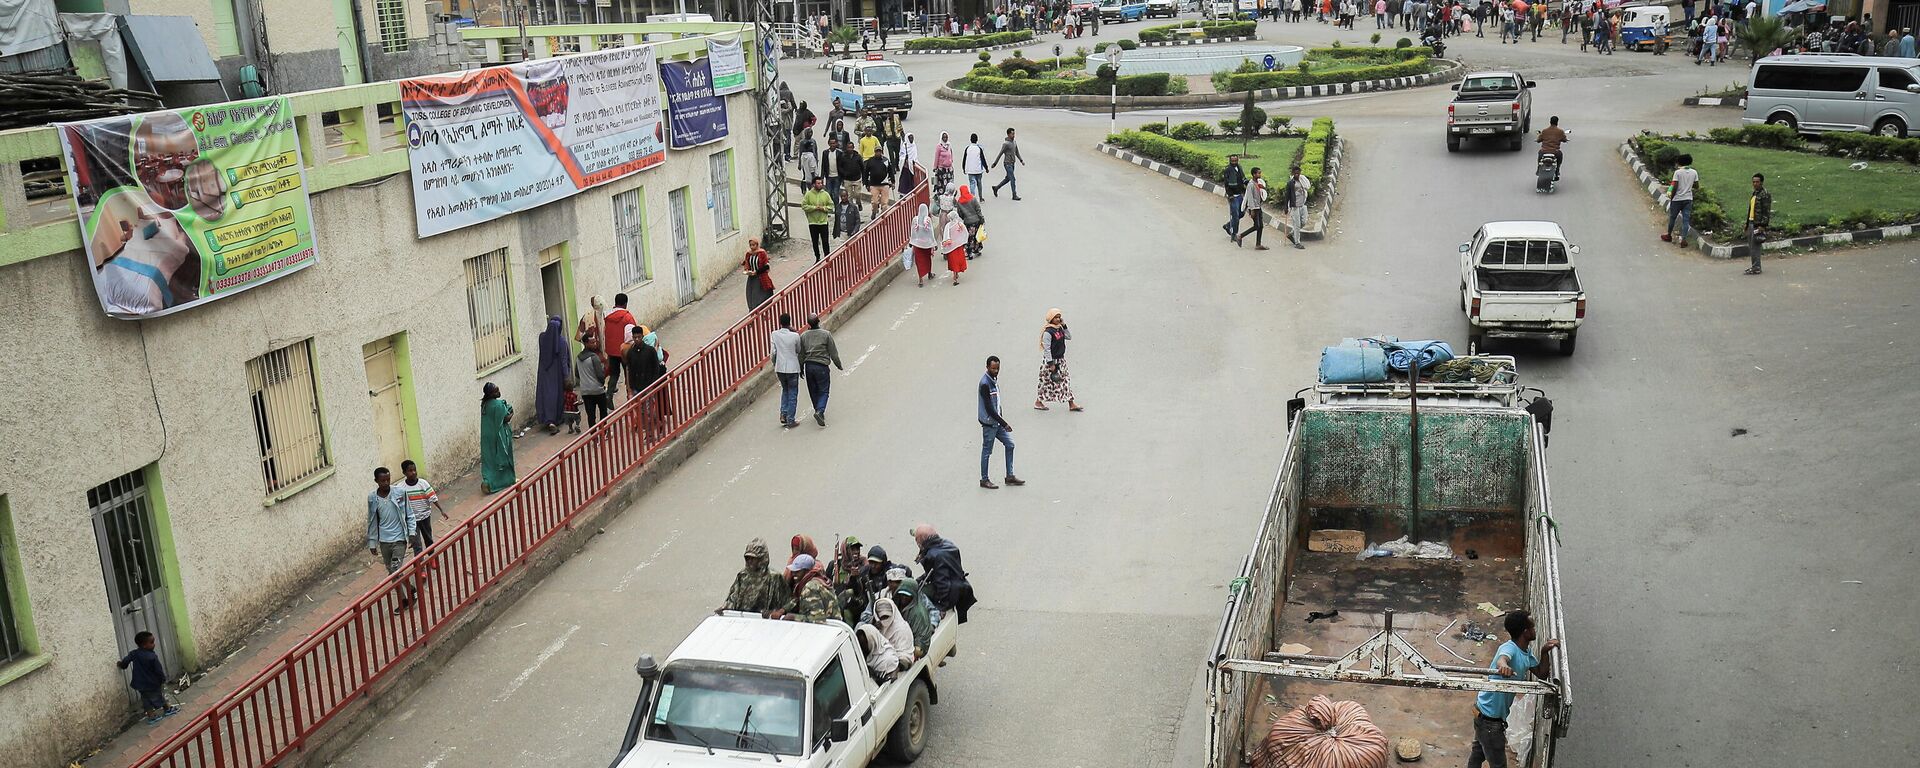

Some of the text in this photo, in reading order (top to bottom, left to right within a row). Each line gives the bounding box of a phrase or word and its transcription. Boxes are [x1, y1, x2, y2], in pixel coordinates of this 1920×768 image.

[429, 108, 452, 119] COLLEGE
[452, 109, 460, 118] OF
[460, 104, 482, 116] ECONOMIC
[481, 117, 504, 138] ልማት
[421, 160, 437, 175] አዲስ
[426, 207, 446, 220] የአዲስ
